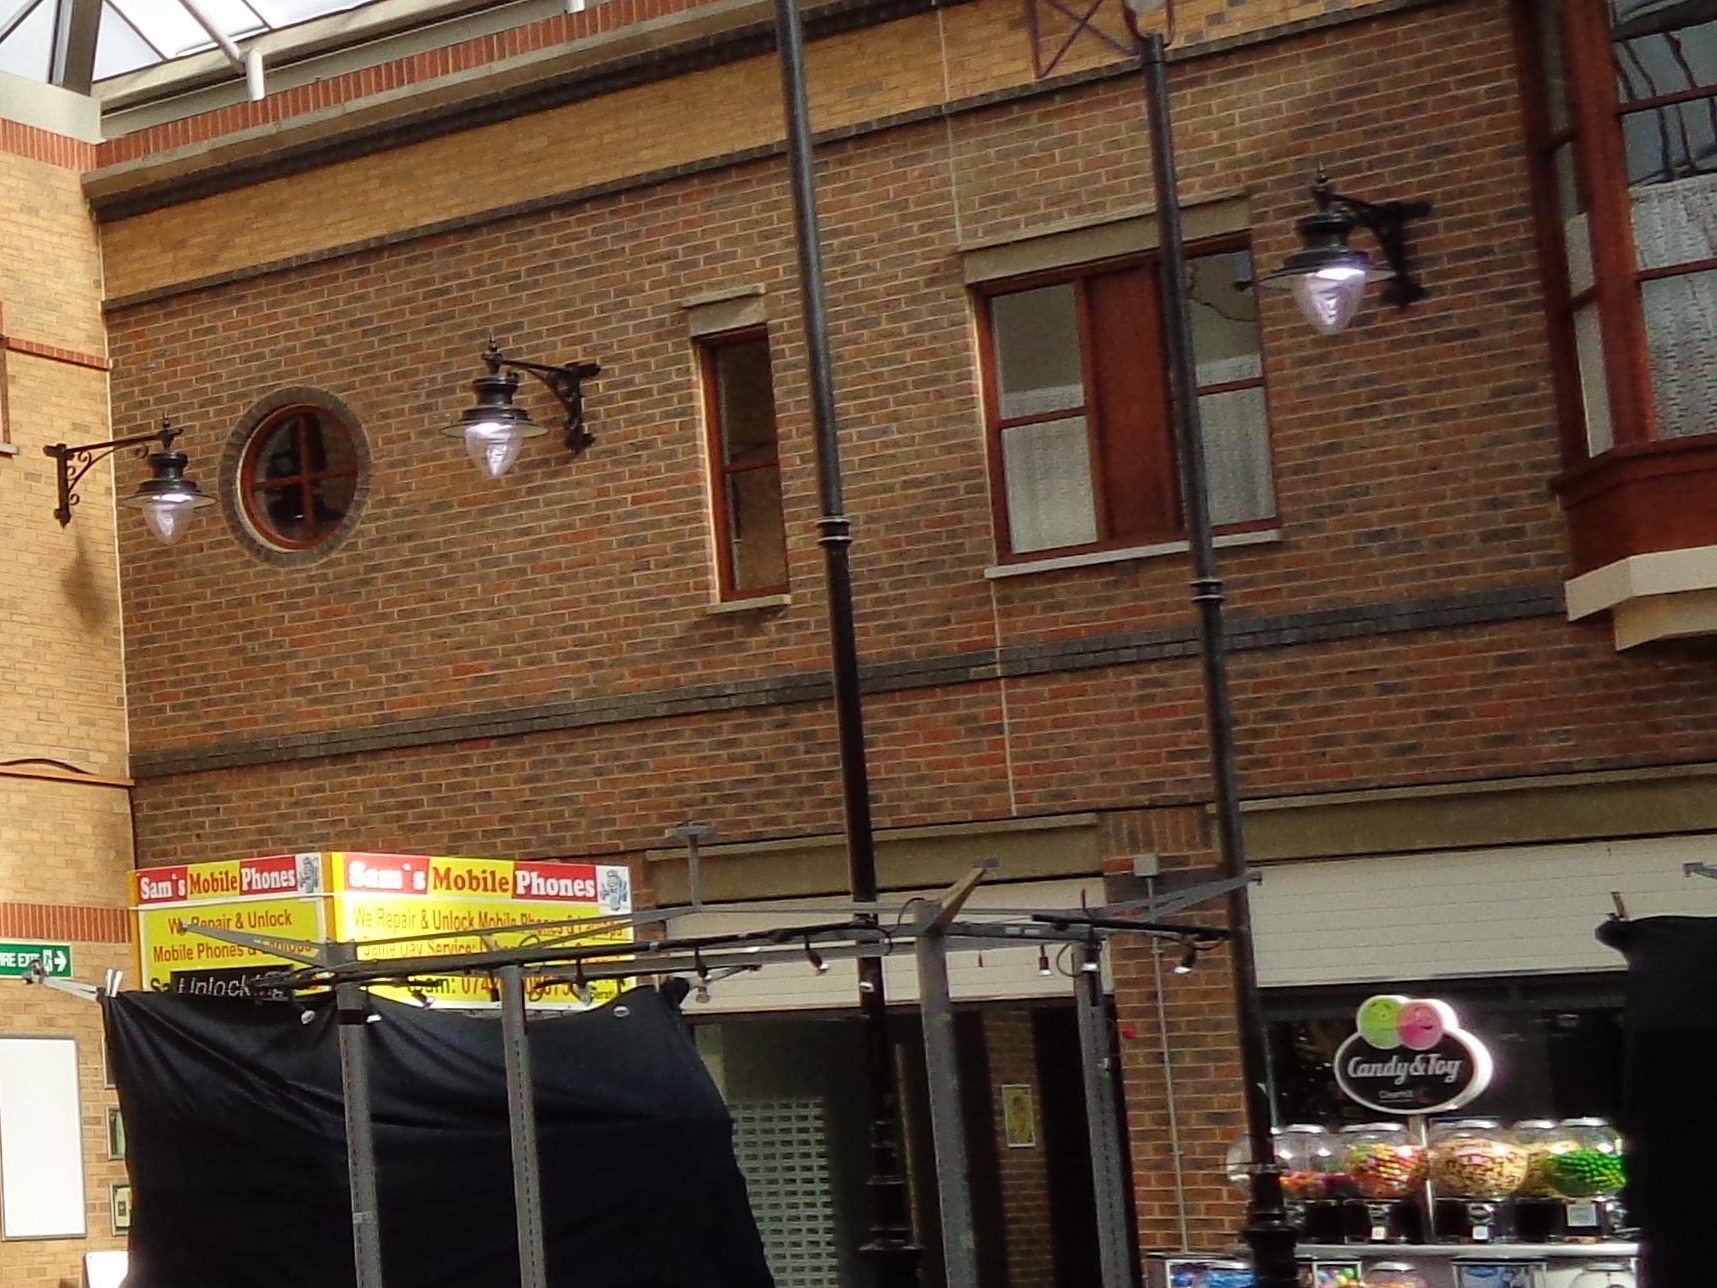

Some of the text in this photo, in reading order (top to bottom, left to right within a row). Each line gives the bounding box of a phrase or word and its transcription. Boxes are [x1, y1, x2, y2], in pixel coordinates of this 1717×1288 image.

[189, 869, 238, 895] Mobile
[241, 865, 296, 891] Phones
[432, 866, 510, 893] Mobile
[515, 870, 595, 897] Phones
[235, 912, 244, 929] &
[248, 909, 292, 929] Unlock
[377, 907, 417, 934] Repair
[420, 909, 430, 929] &
[432, 910, 475, 931] Unlock
[153, 943, 194, 963] Mobile
[197, 942, 244, 959] Phones
